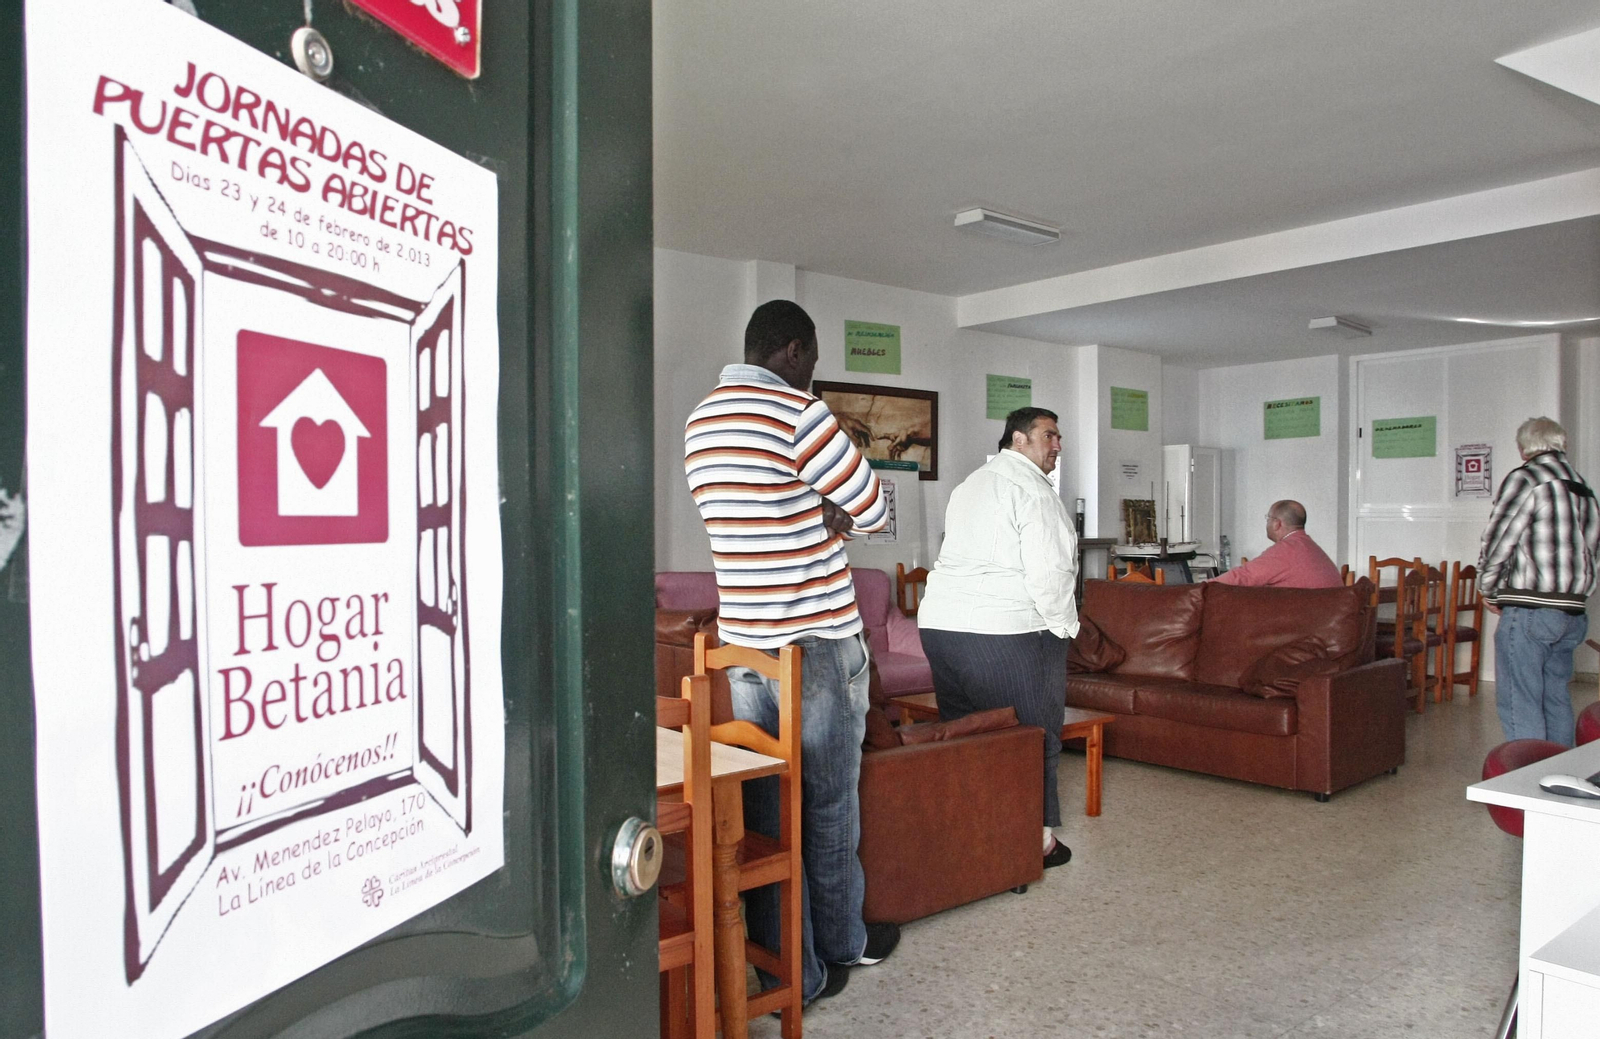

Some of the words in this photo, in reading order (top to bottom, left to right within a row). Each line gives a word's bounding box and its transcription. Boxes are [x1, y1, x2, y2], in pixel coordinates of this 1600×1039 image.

[92, 74, 312, 194] PUERTAS
[321, 173, 474, 257] ABIERTAS
[173, 60, 388, 183] JORNADAS
[395, 161, 436, 206] DE
[221, 179, 241, 201] 23
[250, 193, 259, 213] y
[267, 196, 287, 217] 24
[294, 207, 310, 226] de
[318, 214, 370, 247] febrero
[376, 236, 391, 254] de
[397, 243, 431, 268] 2.013
[260, 220, 278, 240] de
[288, 229, 304, 249] 10
[312, 242, 320, 254] a
[327, 242, 367, 269] 20:00
[373, 255, 380, 272] h
[231, 582, 390, 663] Hogar
[216, 640, 408, 743] Betania
[236, 731, 398, 818] ¡¡Conócenos!!
[216, 866, 245, 890] Av.
[253, 828, 341, 874] Menendez
[346, 809, 397, 838] Pelayo,
[401, 792, 426, 816] 170
[219, 895, 241, 917] La
[248, 871, 295, 905] Línea
[302, 860, 322, 880] de
[328, 851, 341, 870] la
[346, 817, 425, 861] Concepción
